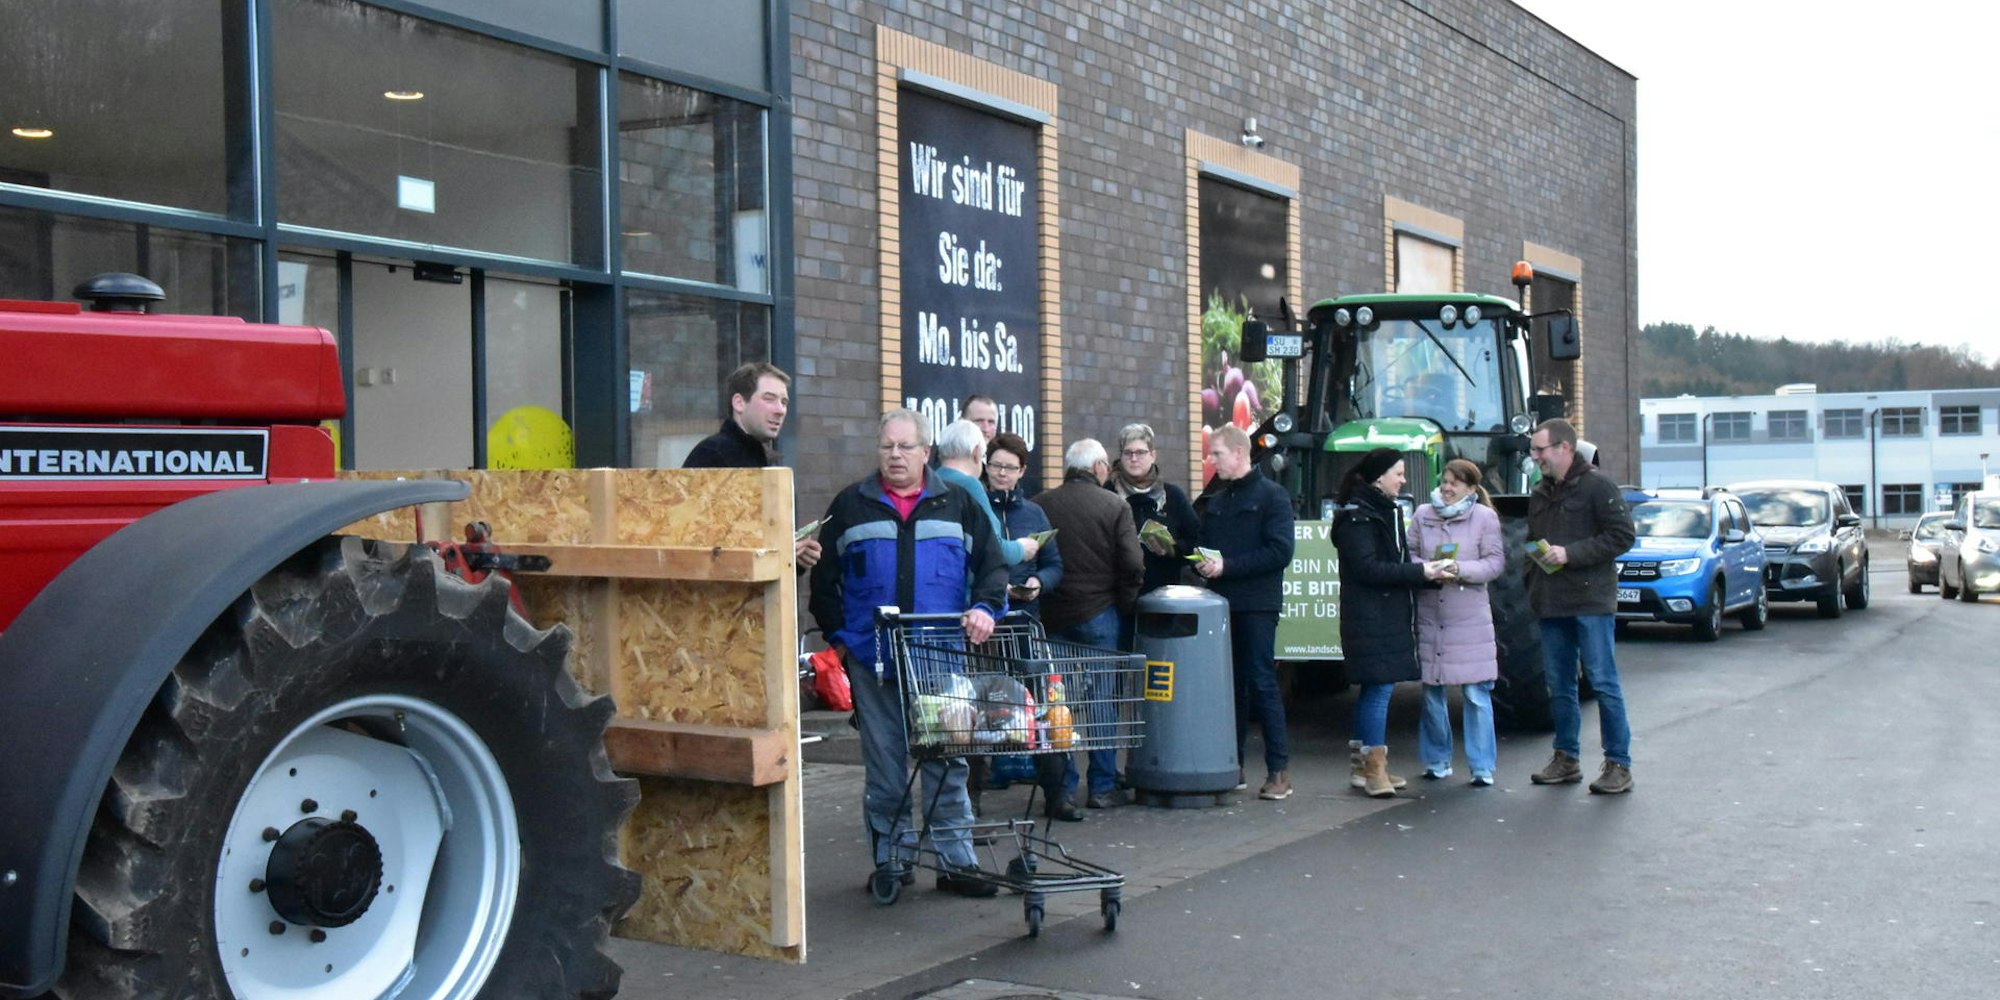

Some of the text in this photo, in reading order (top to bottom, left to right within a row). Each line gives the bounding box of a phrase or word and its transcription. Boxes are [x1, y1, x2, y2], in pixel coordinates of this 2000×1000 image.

[910, 141, 1025, 217] Wir sind für
[939, 231, 1002, 292] Sie da:
[919, 311, 1023, 373] Mo. bis Sa.
[0, 450, 254, 473] NTERNATIONAL
[1317, 526, 1331, 540] V
[1292, 559, 1321, 574] BIN
